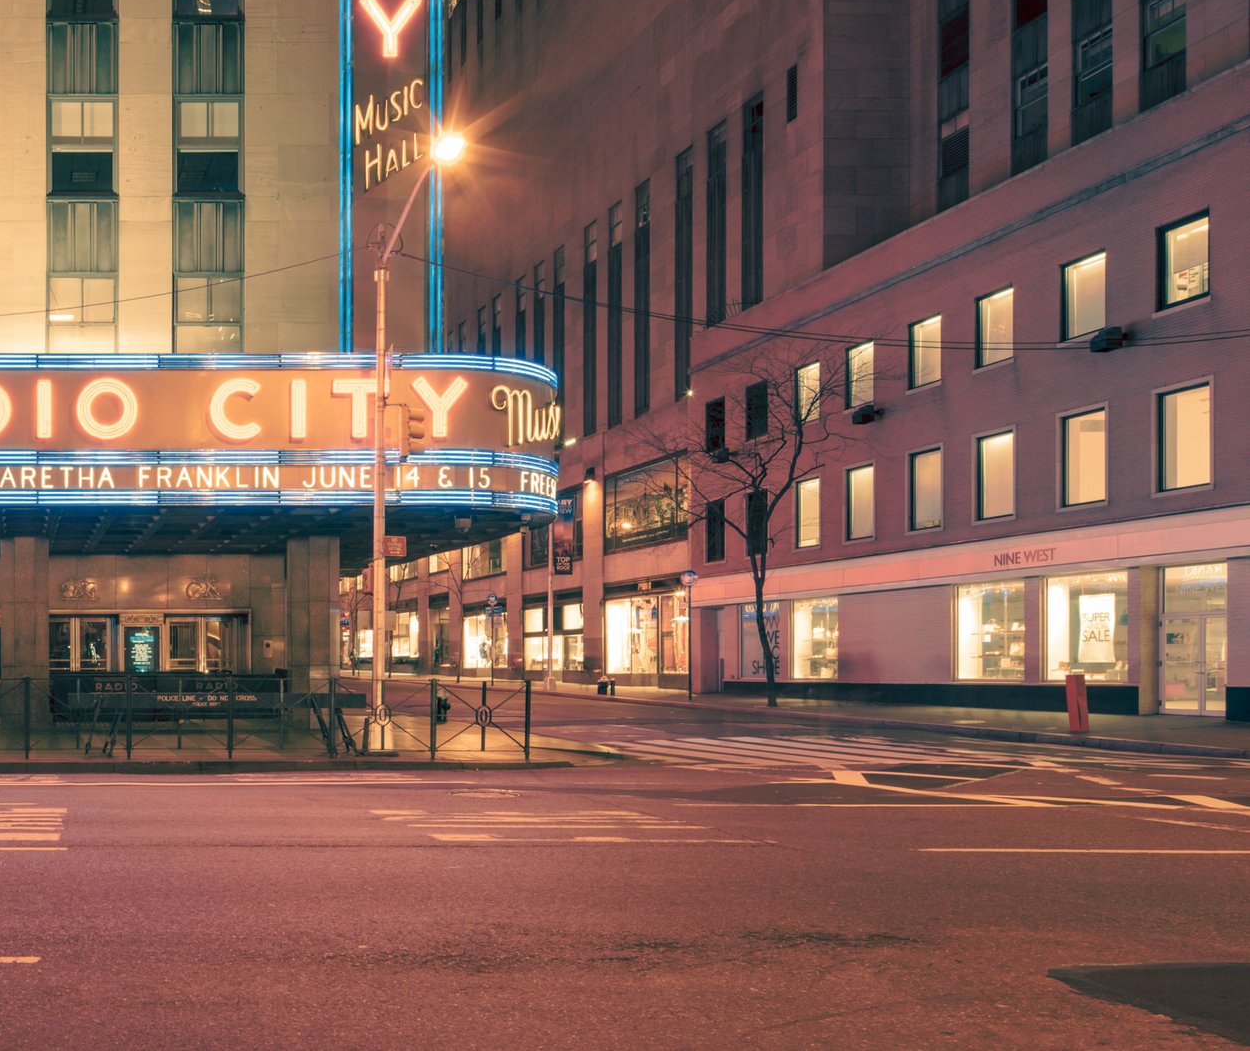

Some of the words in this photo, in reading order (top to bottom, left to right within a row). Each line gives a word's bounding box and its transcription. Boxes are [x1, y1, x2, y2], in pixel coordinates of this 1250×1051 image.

[209, 376, 470, 441] CITY
[0, 466, 115, 489] ARETHA
[138, 466, 280, 488] FRANKLIN
[302, 466, 371, 488] JUNE
[396, 466, 420, 487] 14
[438, 466, 453, 486] &
[469, 466, 491, 488] 15
[993, 551, 1021, 566] NINE
[1023, 548, 1056, 563] WEST
[1082, 630, 1111, 643] SALE
[752, 660, 780, 675] SHE
